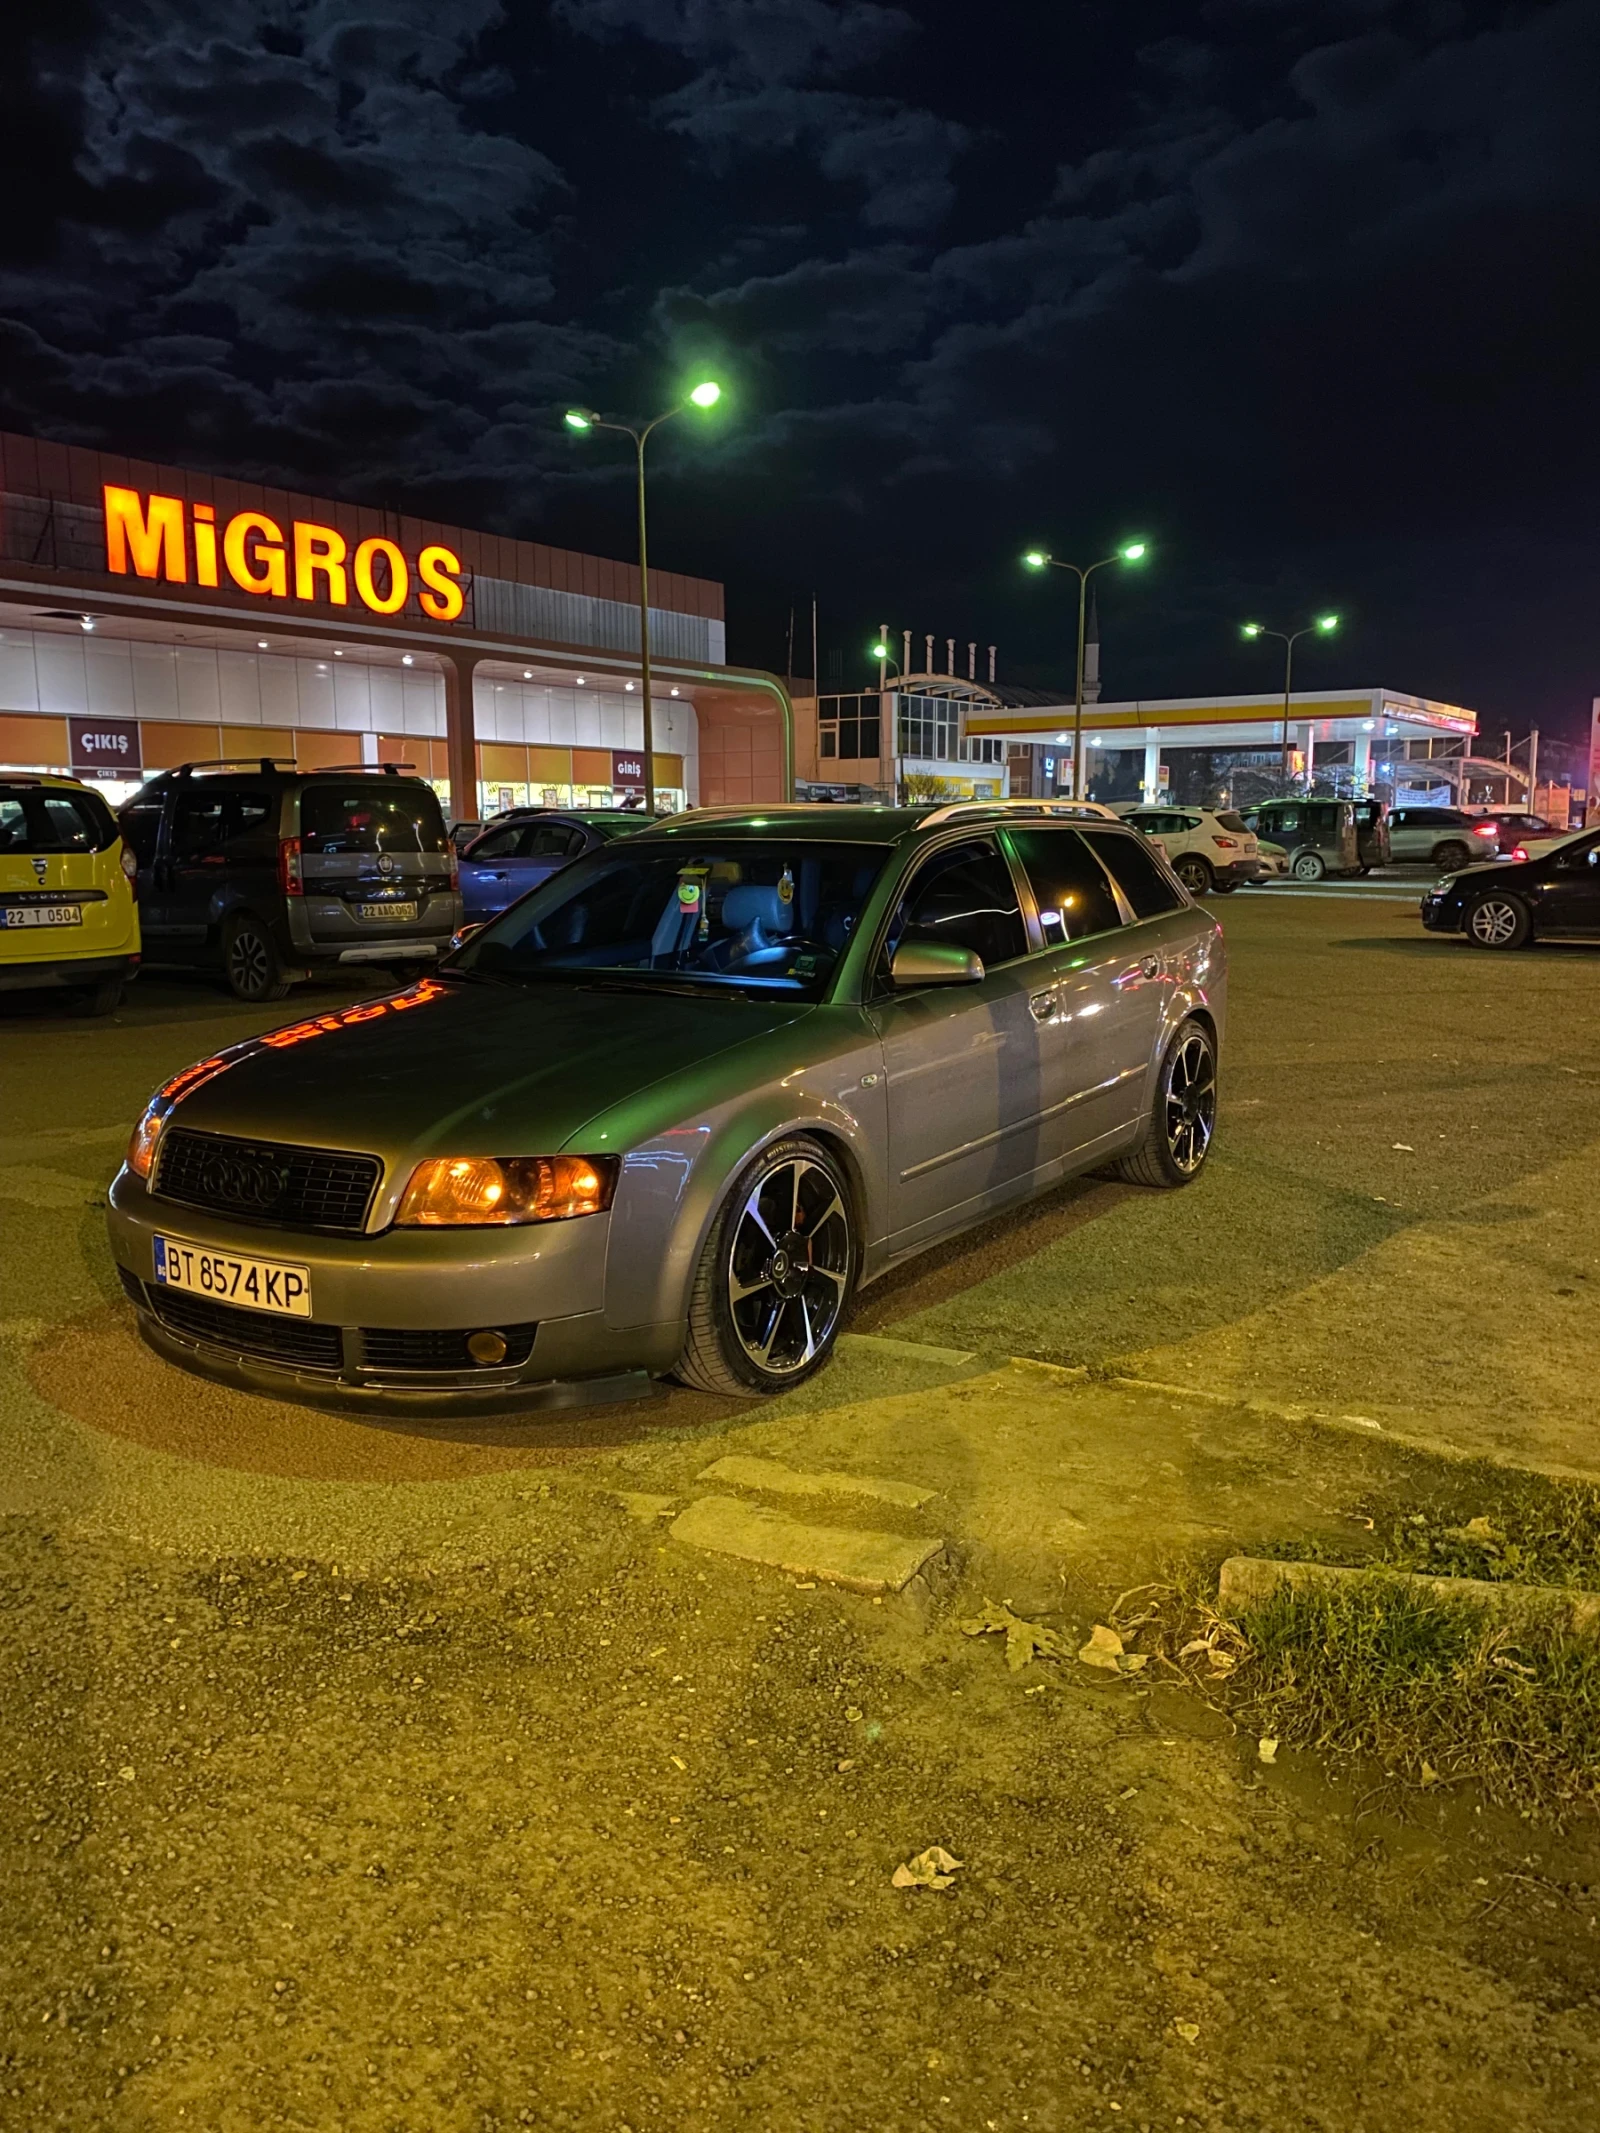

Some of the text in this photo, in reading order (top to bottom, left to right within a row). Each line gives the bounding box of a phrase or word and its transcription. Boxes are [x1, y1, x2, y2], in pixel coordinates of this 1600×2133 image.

[81, 733, 129, 754] ÇIKIŞ
[617, 760, 641, 778] GİRİŞ
[8, 908, 78, 923] 22 T 0504
[363, 906, 376, 917] 22
[167, 1247, 303, 1308] BT 8574 KP
